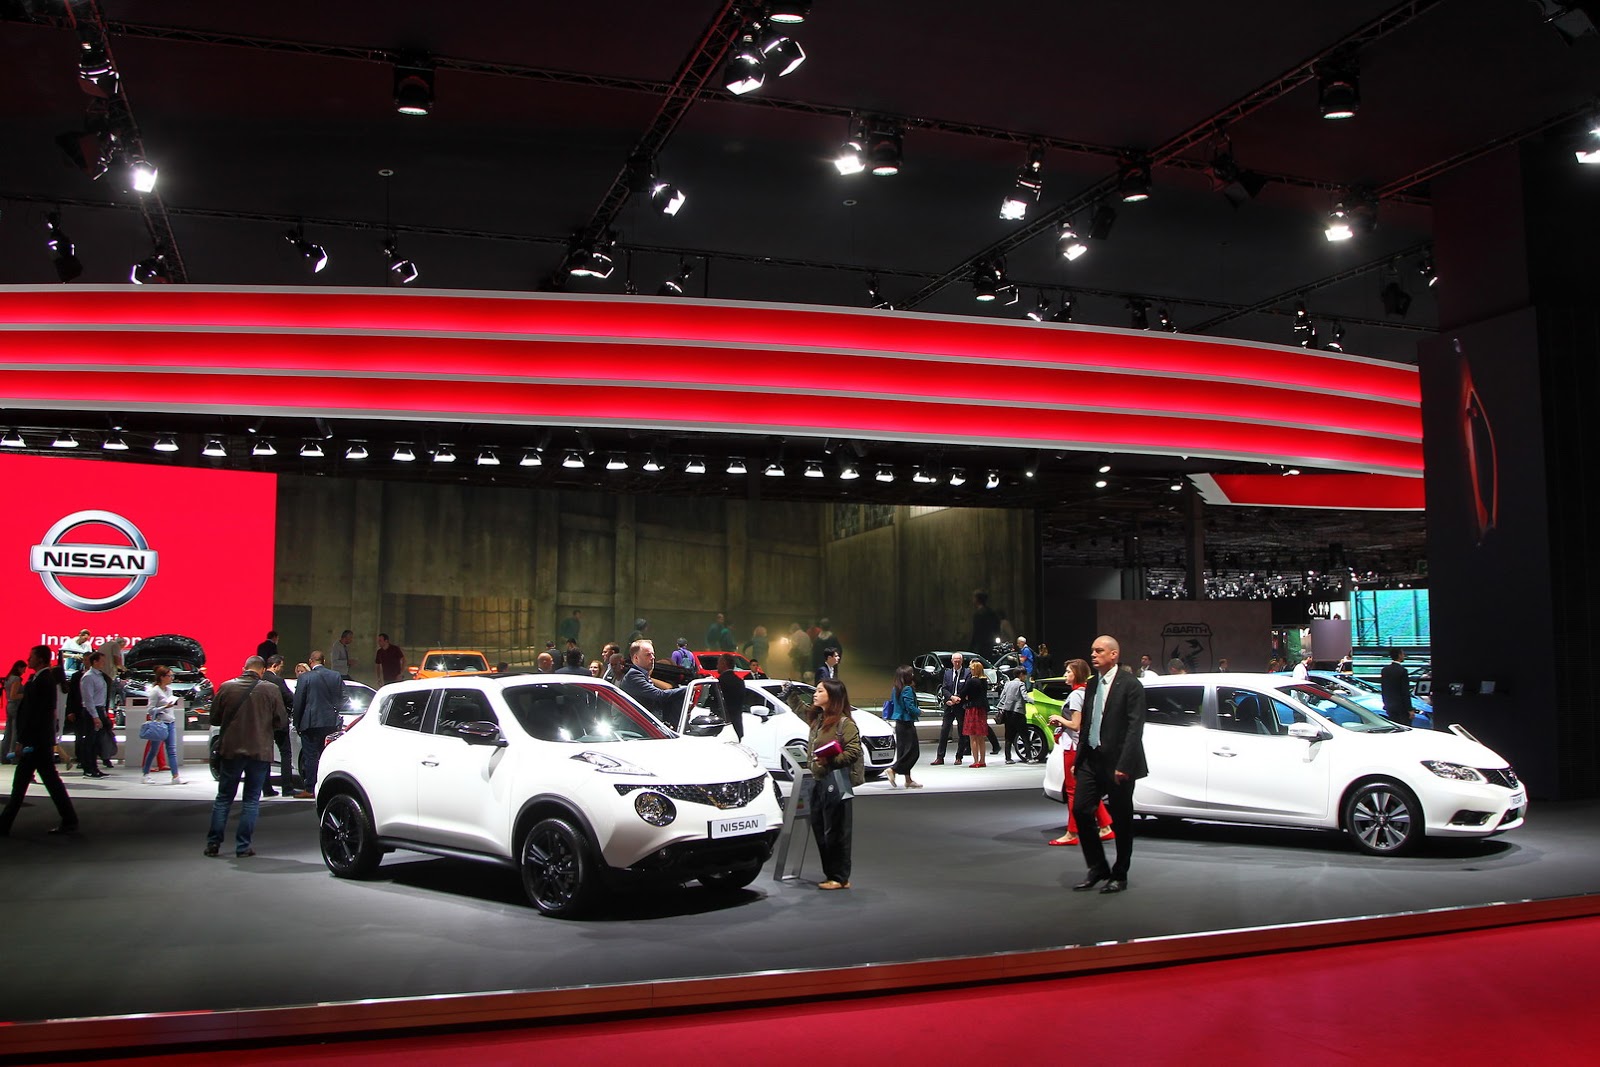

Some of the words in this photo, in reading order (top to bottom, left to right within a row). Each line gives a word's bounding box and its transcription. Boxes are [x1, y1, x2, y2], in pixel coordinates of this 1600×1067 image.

[43, 551, 145, 570] NISSAN
[1165, 626, 1207, 634] ABARTH
[720, 819, 759, 833] NISSAN
